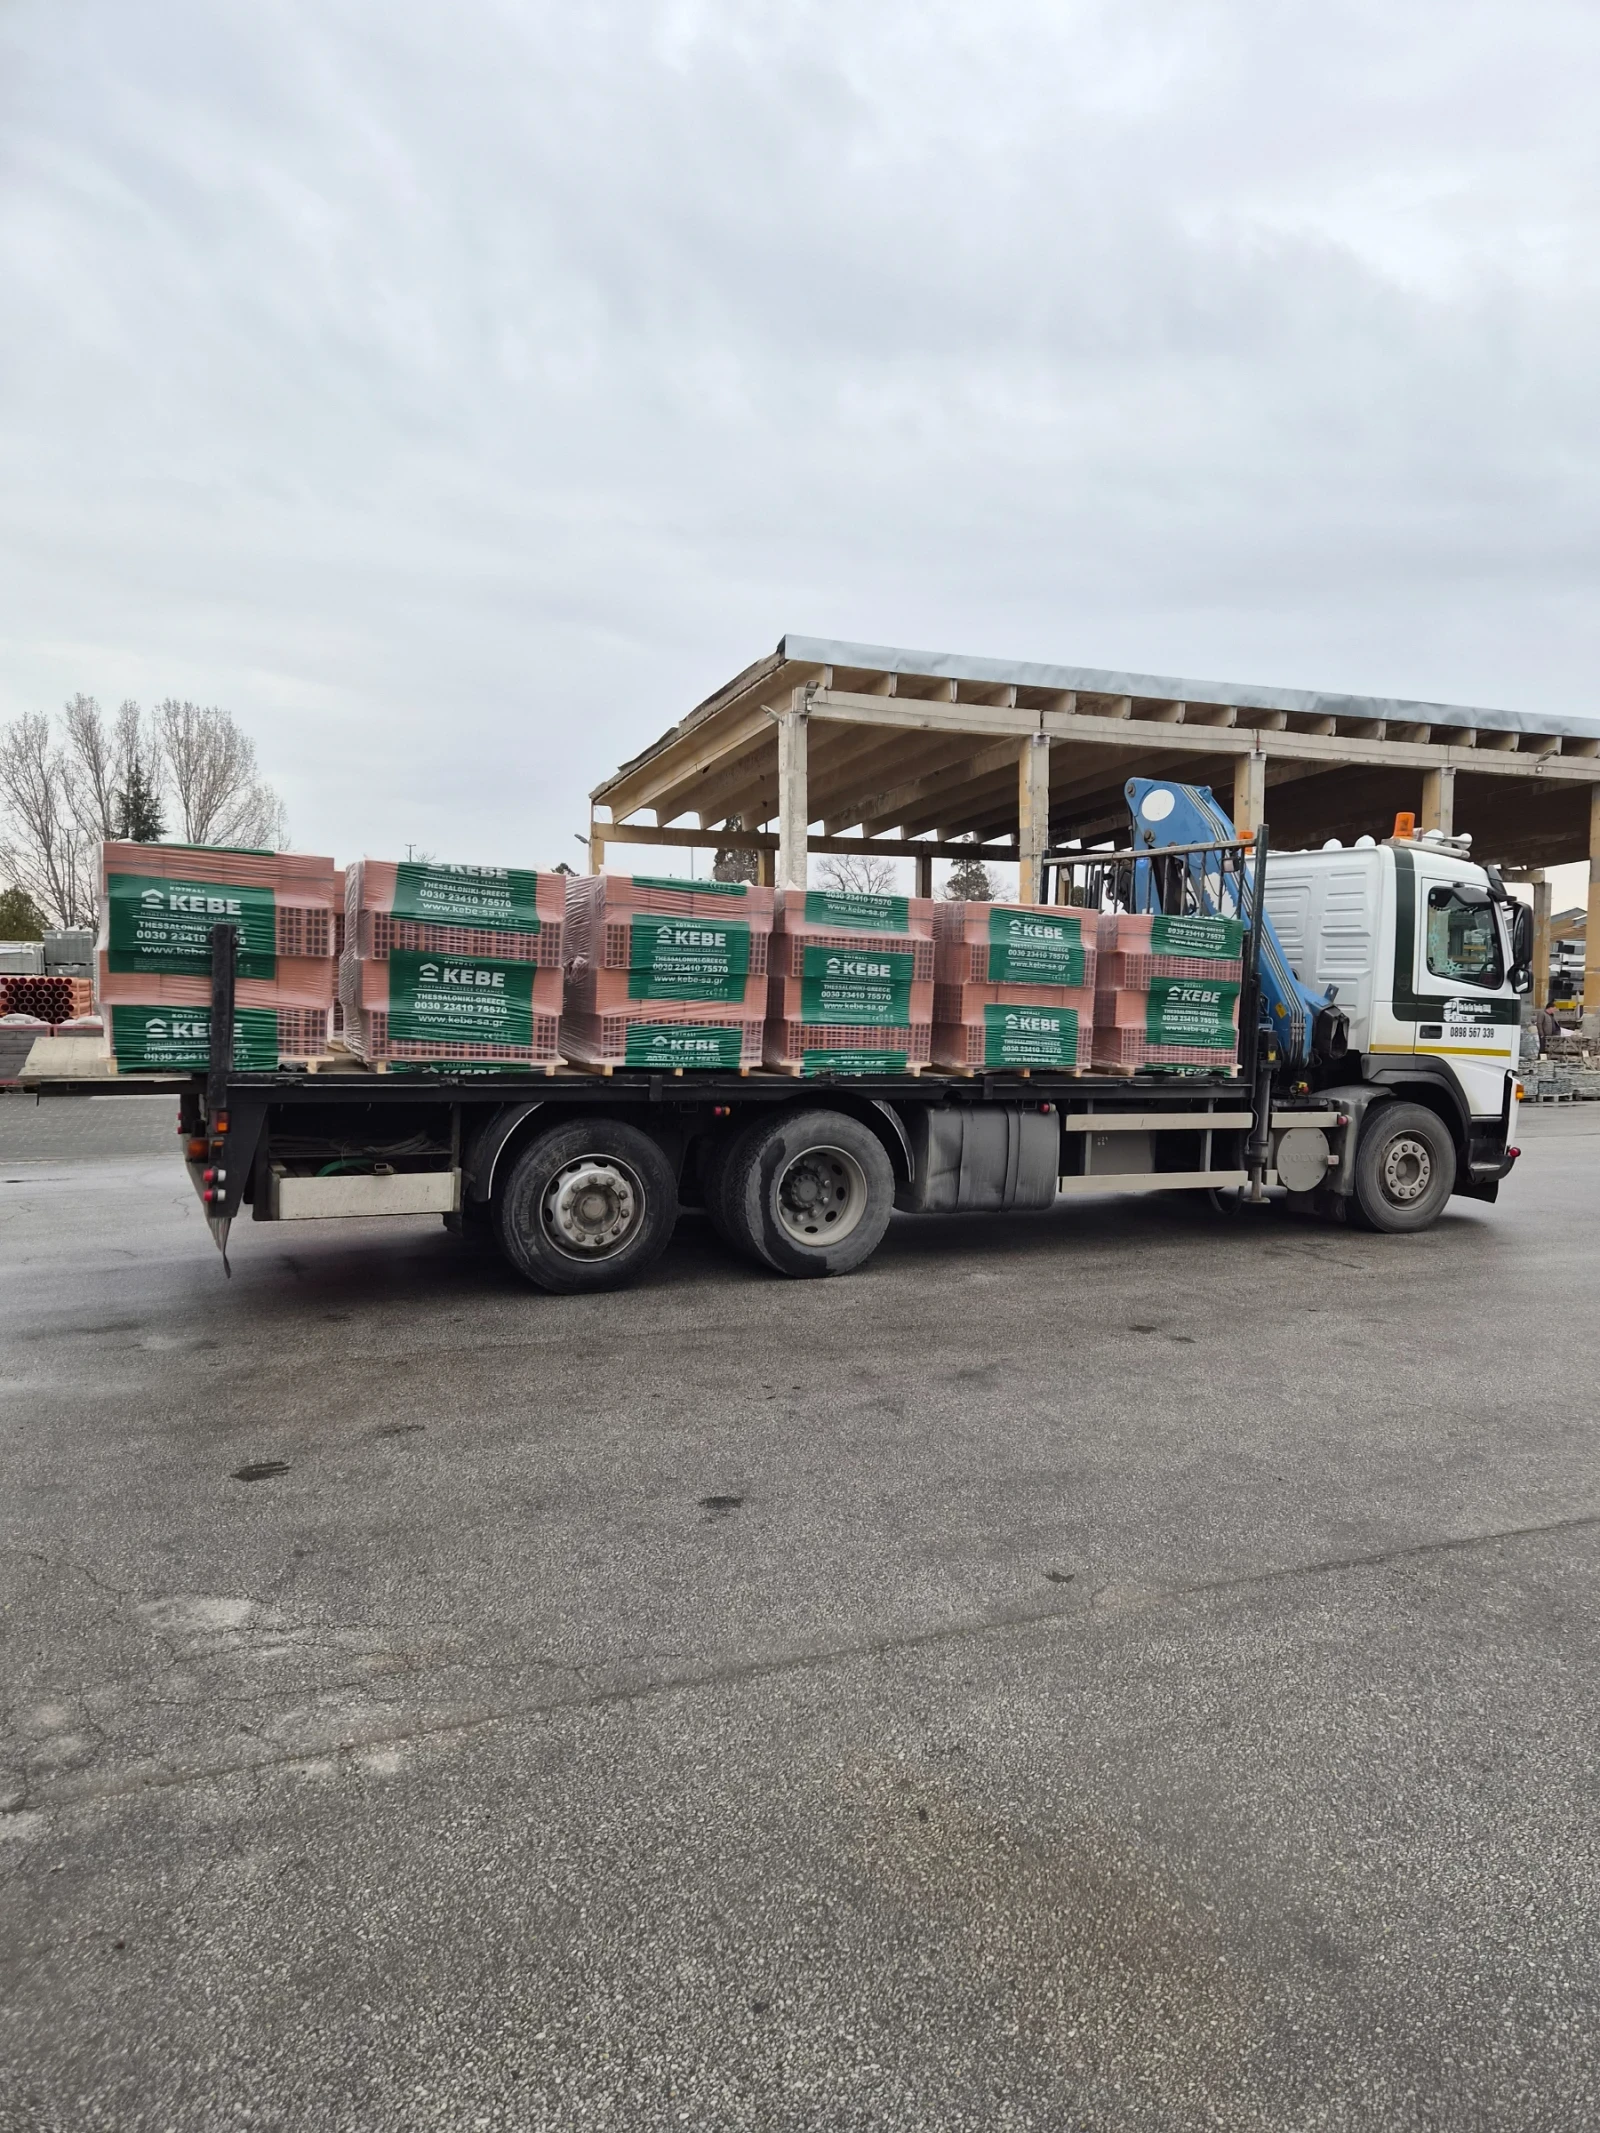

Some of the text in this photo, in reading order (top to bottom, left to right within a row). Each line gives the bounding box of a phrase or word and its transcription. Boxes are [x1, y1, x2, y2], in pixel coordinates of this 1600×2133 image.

[450, 864, 508, 879] KEBE
[423, 881, 510, 898] THESSALONIKI-GREECE
[169, 895, 242, 915] KEBE
[420, 889, 512, 907] 0030 23410 75570
[825, 890, 892, 906] 0030 23410 75570
[827, 903, 889, 917] www.kebe-sa.gr
[139, 921, 245, 935] THESSALONIKI-GE
[1023, 924, 1064, 940] KEBE
[1167, 927, 1185, 935] 0030
[1185, 930, 1205, 938] 23410
[136, 930, 167, 940] 0030
[171, 933, 207, 942] 23410
[675, 930, 726, 947] KEBE
[141, 946, 242, 958] www.kebe-r
[1027, 950, 1047, 958] 23410
[1049, 952, 1070, 960] 75570
[675, 964, 700, 972] 23410
[702, 965, 728, 973] 75570
[843, 961, 891, 977] KEBE
[443, 967, 505, 987] KEBE
[654, 975, 724, 985] wwwkebe-sa.gr
[416, 993, 506, 1005] THESSALONIKI-GREECE
[841, 991, 865, 999] 23410
[1181, 989, 1221, 1003] KEBE
[414, 1001, 507, 1014] 0030 23410 75570
[418, 1015, 504, 1027] www.kebe-sa.gr
[1020, 1017, 1060, 1031] KEBE
[1179, 1015, 1198, 1023] 23410
[172, 1022, 243, 1038] KEE
[1450, 1026, 1495, 1039] 0898 567 339
[670, 1039, 720, 1051] KEBE
